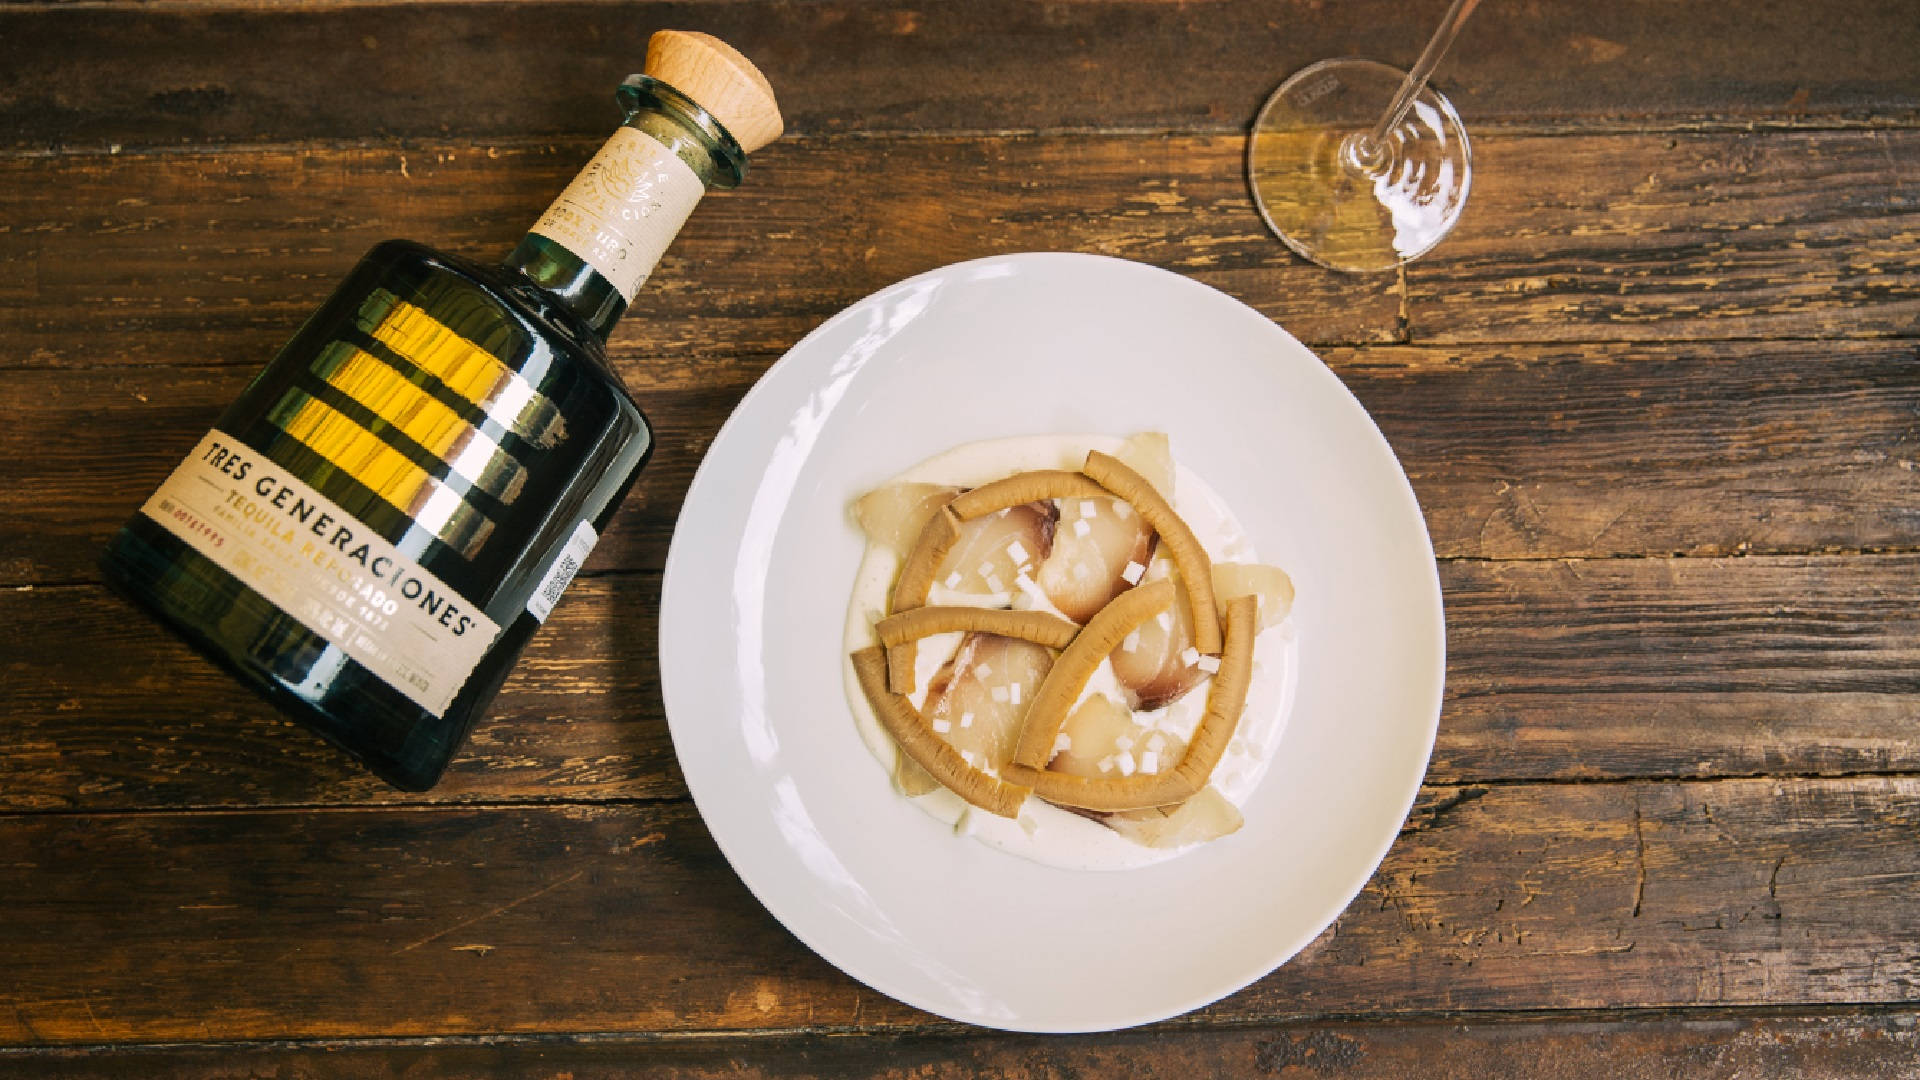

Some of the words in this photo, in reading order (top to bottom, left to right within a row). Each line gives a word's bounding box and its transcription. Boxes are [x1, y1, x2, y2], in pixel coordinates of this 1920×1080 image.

[202, 442, 252, 481] TRES
[255, 475, 472, 637] GENERACIONES
[226, 488, 297, 545] TEQUILA
